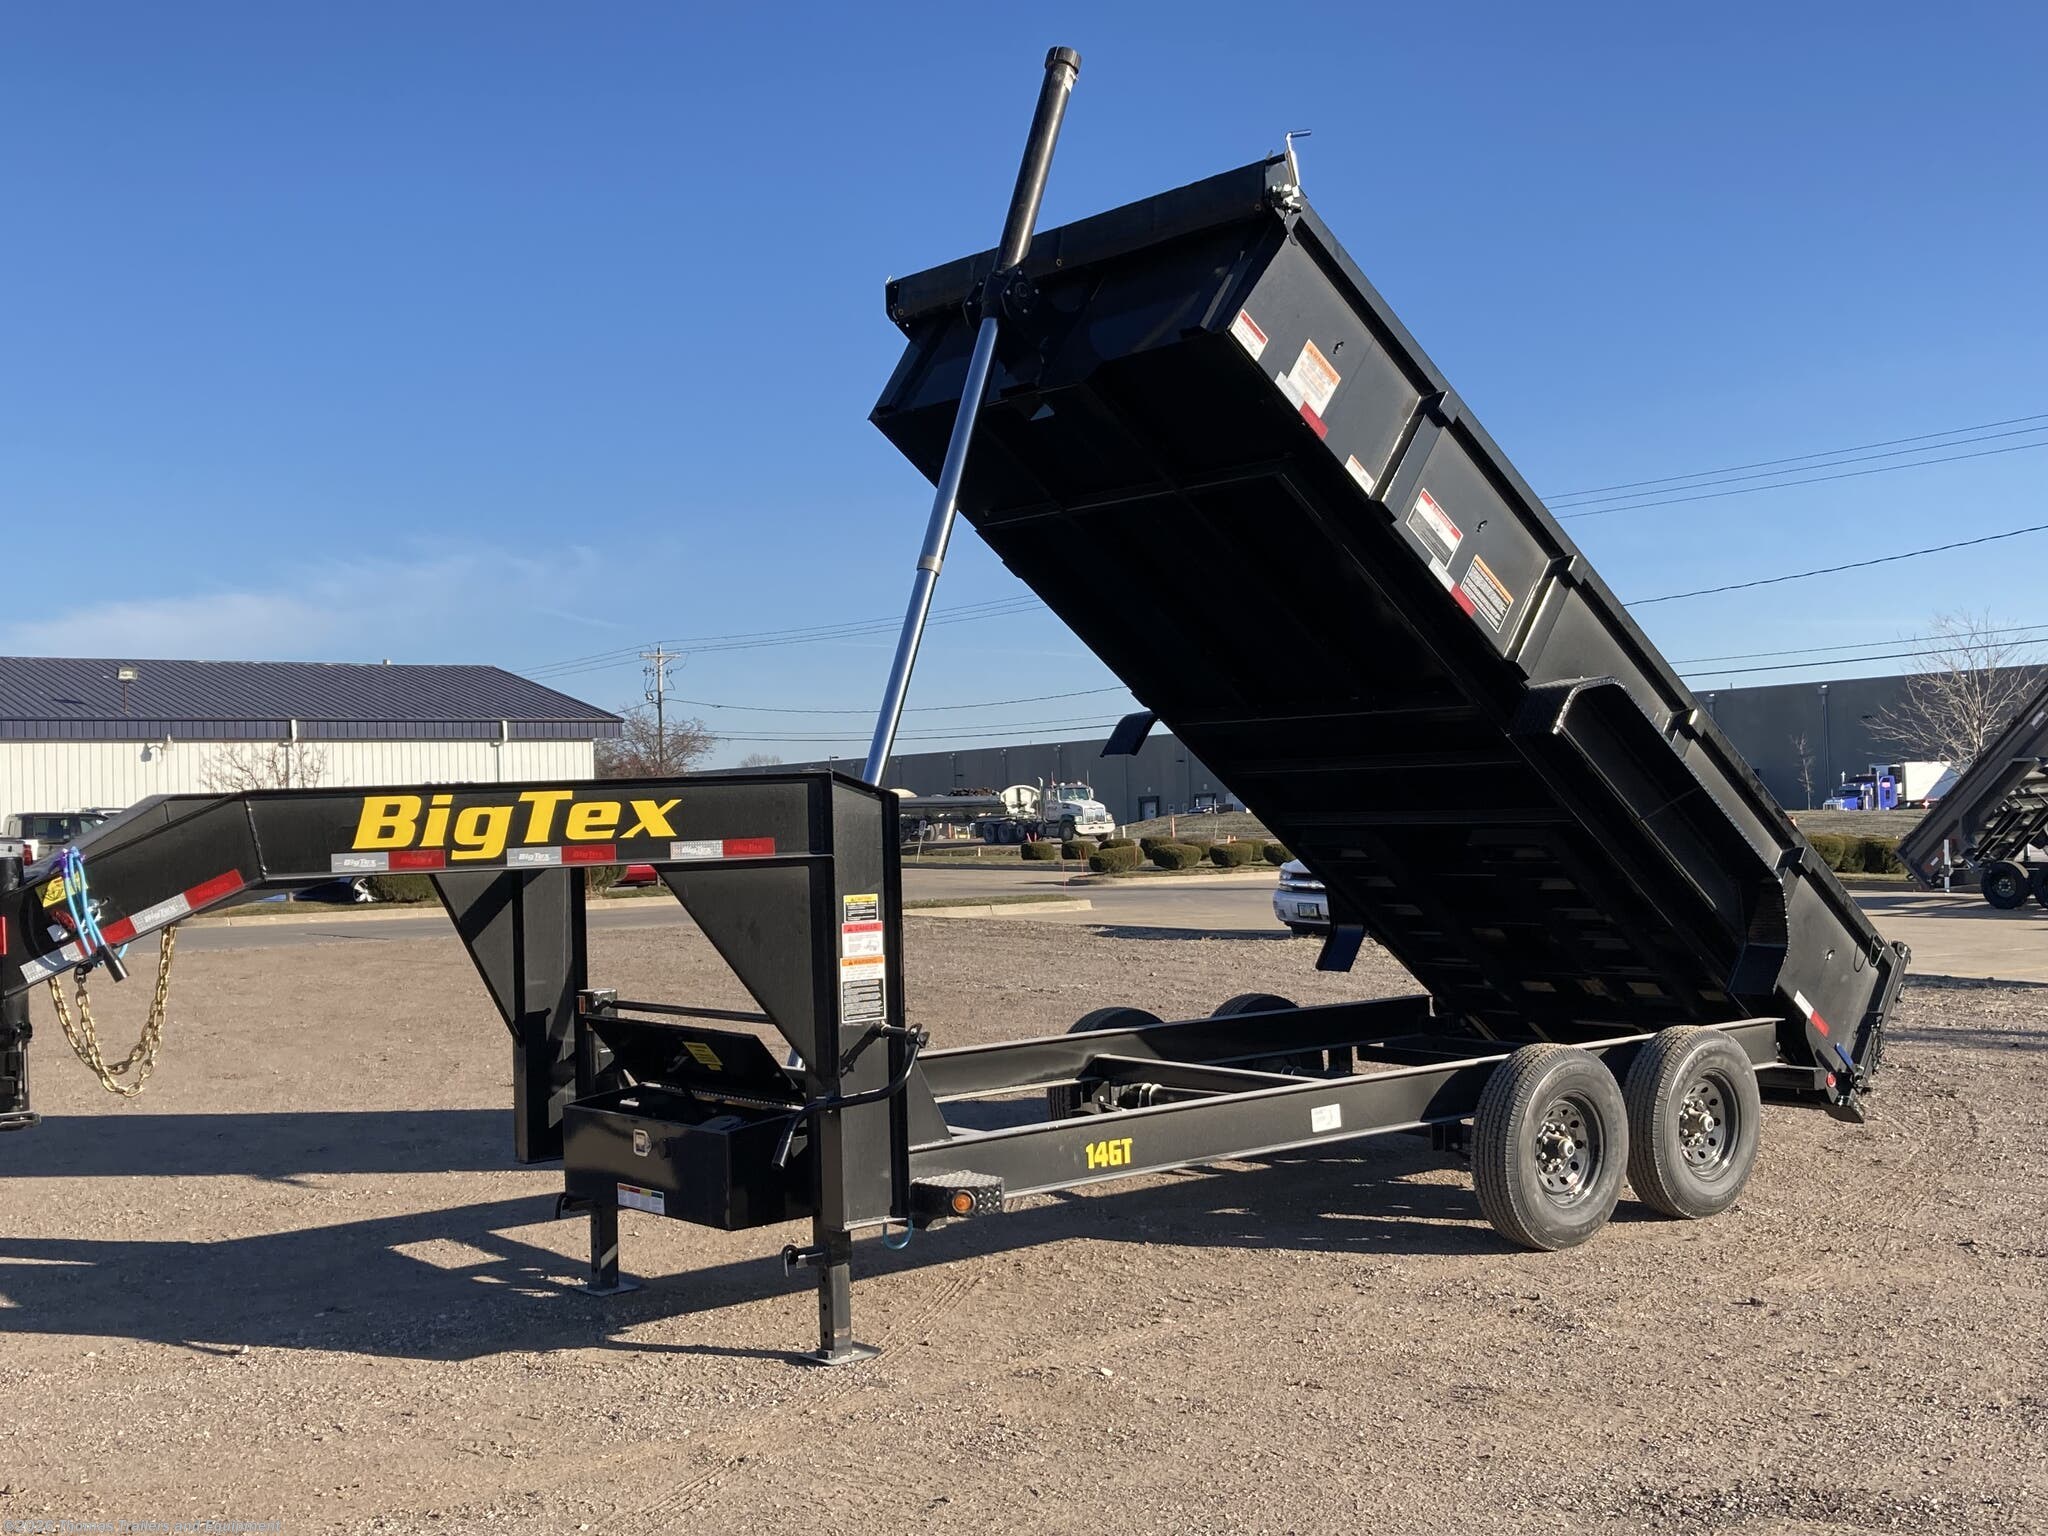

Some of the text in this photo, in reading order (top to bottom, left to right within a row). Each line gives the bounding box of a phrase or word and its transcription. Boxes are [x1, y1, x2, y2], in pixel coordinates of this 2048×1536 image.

[352, 791, 682, 860] BigTex
[343, 857, 377, 868] BigTex
[518, 851, 551, 862] BigTex
[1085, 1138, 1133, 1169] 14GT
